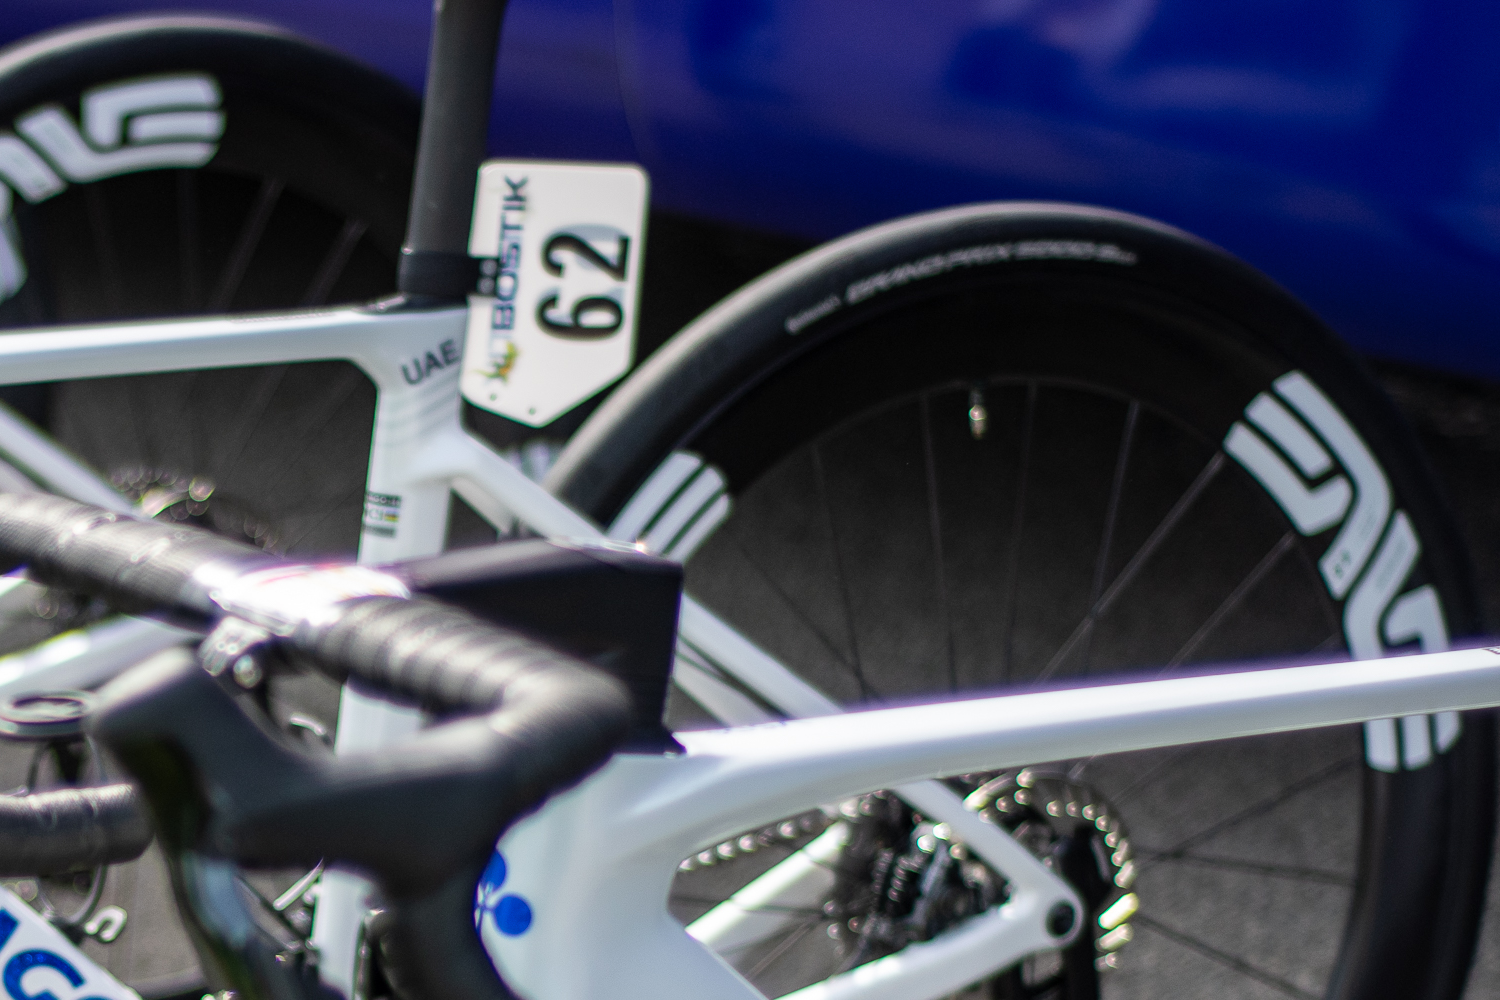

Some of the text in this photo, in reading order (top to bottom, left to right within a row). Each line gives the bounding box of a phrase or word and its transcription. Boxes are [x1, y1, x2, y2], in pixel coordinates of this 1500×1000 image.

[492, 175, 529, 330] BOSTIK
[535, 231, 632, 342] 62
[402, 339, 460, 386] UAE
